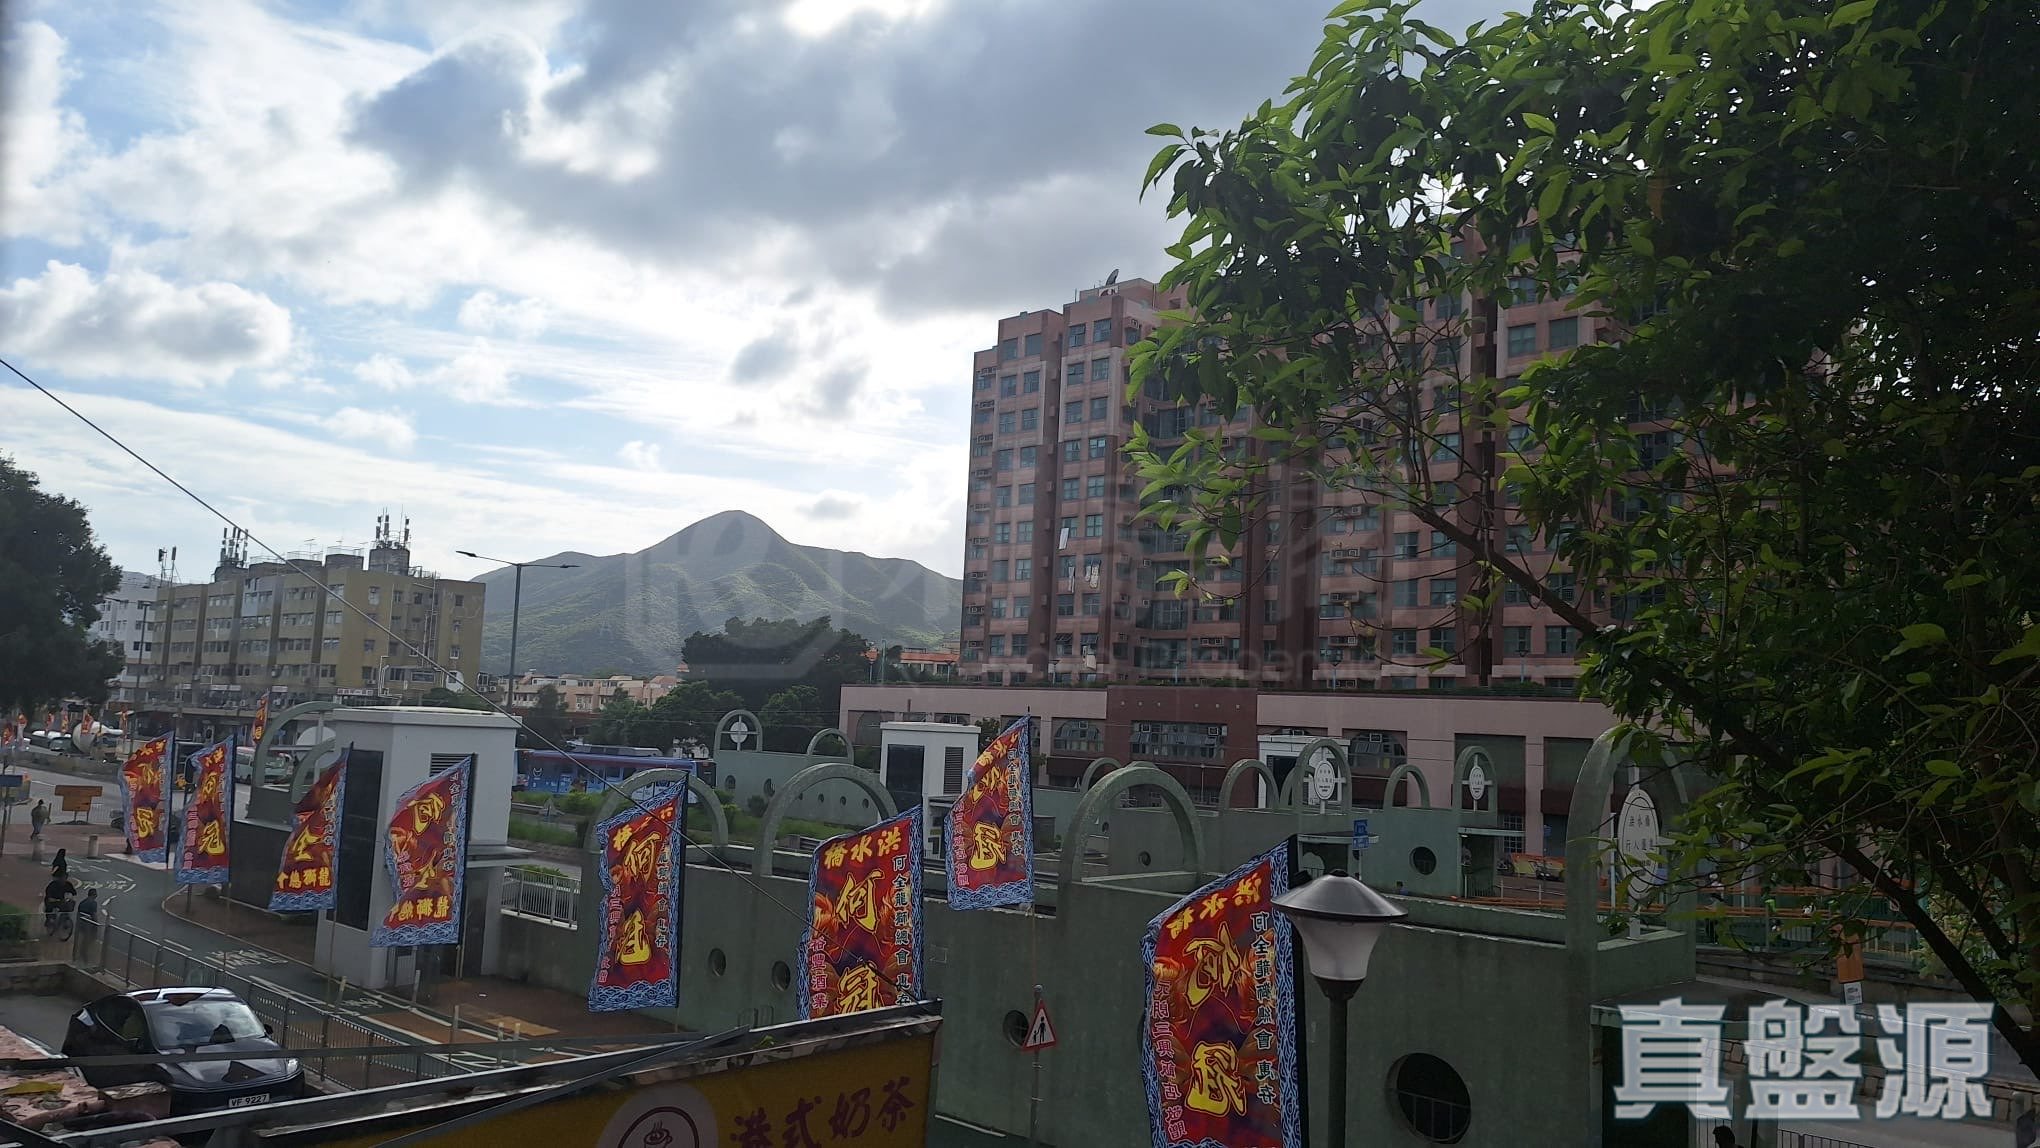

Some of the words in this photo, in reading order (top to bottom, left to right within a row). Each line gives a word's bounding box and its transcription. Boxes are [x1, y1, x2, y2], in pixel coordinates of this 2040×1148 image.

[892, 854, 910, 966] 何全龍獅總會
[245, 1094, 268, 1105] 9227
